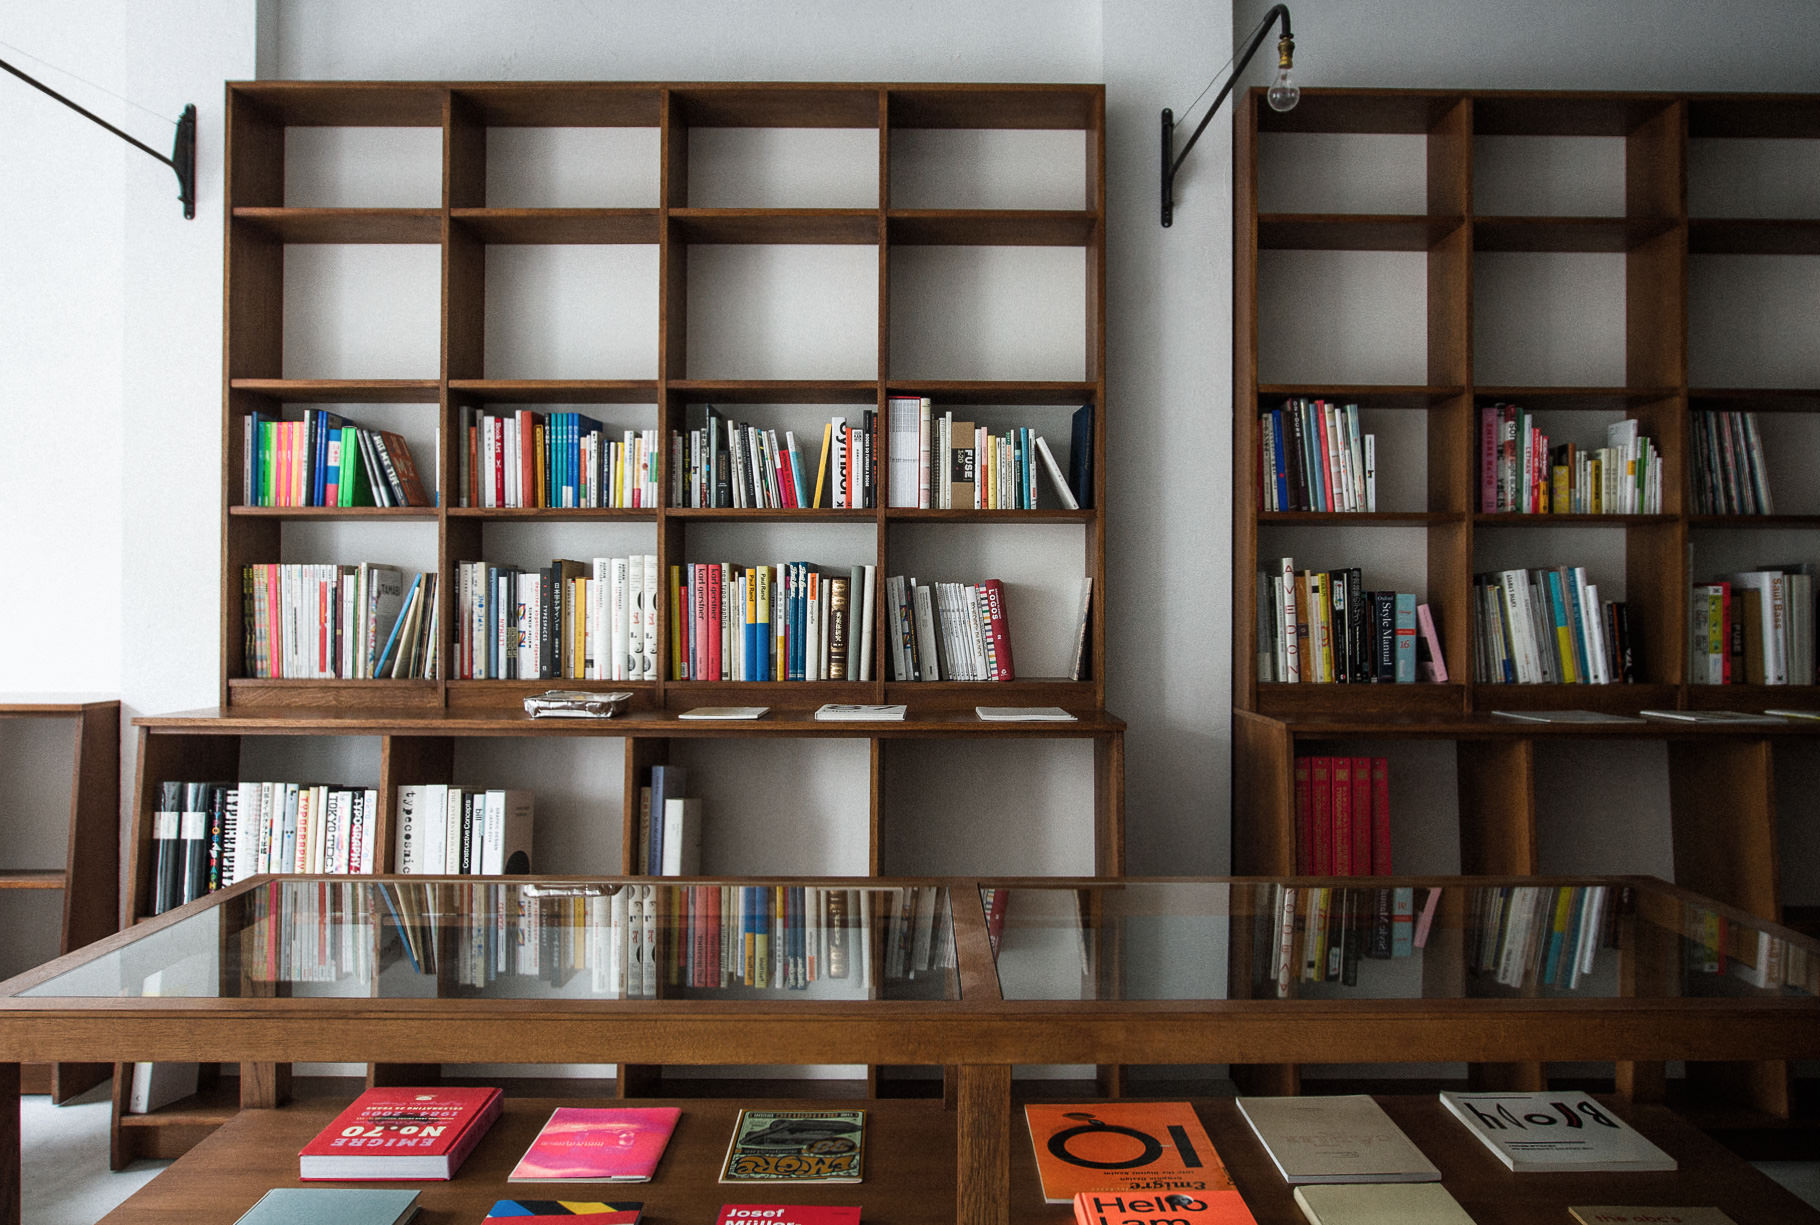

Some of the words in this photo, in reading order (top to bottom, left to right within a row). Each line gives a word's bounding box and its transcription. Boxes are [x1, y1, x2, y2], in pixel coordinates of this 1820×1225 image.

[964, 449, 973, 478] FUSE
[698, 568, 706, 585] karl
[711, 568, 719, 585] karl
[748, 574, 756, 587] Paul
[1772, 577, 1783, 601] Saul
[697, 586, 705, 621] gerstner
[710, 586, 718, 621] gerstner
[748, 587, 756, 602] Rand
[988, 588, 999, 620] LOGOS
[1284, 564, 1299, 675] AVEDON
[1380, 602, 1391, 627] Style
[1773, 603, 1783, 630] Bass
[1383, 629, 1392, 666] Manual
[1399, 640, 1411, 649] 16
[1733, 624, 1742, 652] FUSE
[327, 796, 339, 832] TOKYO
[464, 799, 472, 829] Concepts
[475, 808, 483, 821] bill
[297, 796, 309, 870] TYPOGRAPHY
[350, 797, 364, 868] TYPOGRAPHY
[462, 829, 471, 869] Constructive
[330, 1137, 436, 1147] EMIGRE
[1129, 1180, 1207, 1190] Emigre
[726, 1208, 785, 1218] Josef
[1594, 1215, 1627, 1223] the
[1632, 1215, 1683, 1223] abc's
